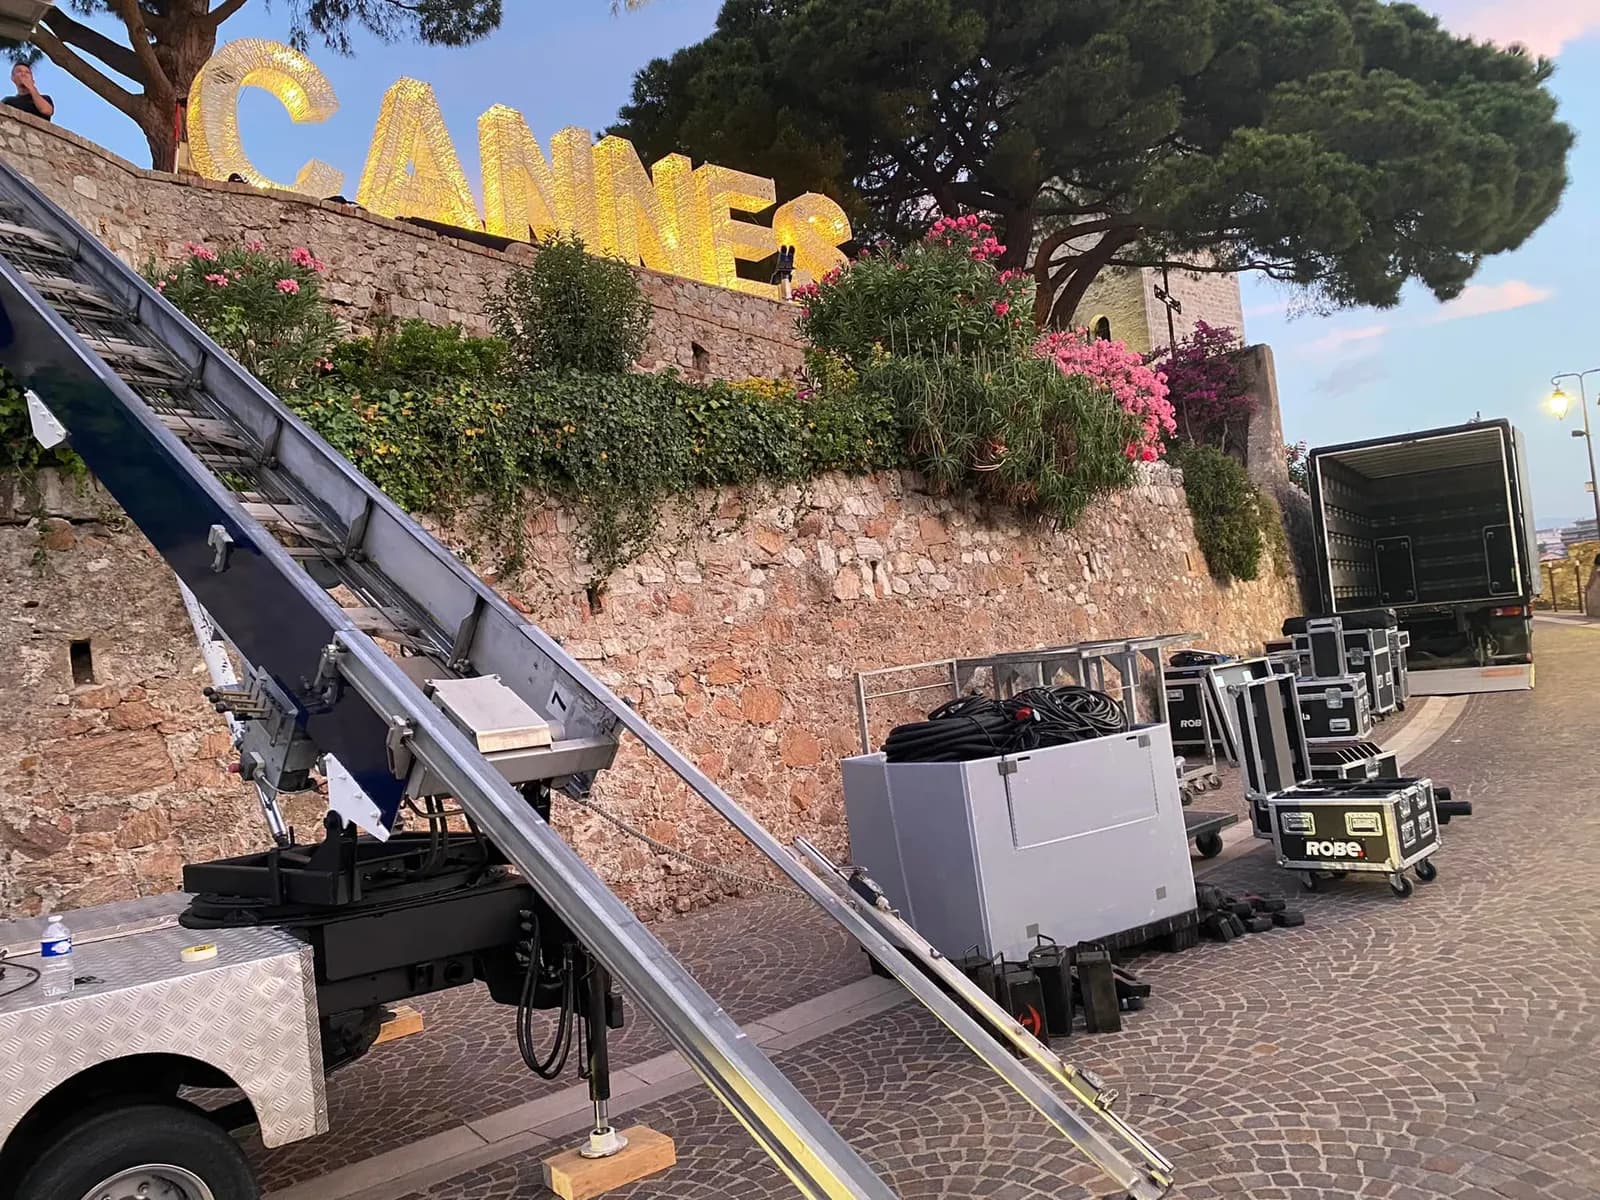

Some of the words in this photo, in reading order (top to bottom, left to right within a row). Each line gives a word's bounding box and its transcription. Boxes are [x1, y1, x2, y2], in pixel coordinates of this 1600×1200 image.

[186, 38, 852, 301] CANNES
[551, 688, 567, 712] 7
[1180, 719, 1202, 728] ROB
